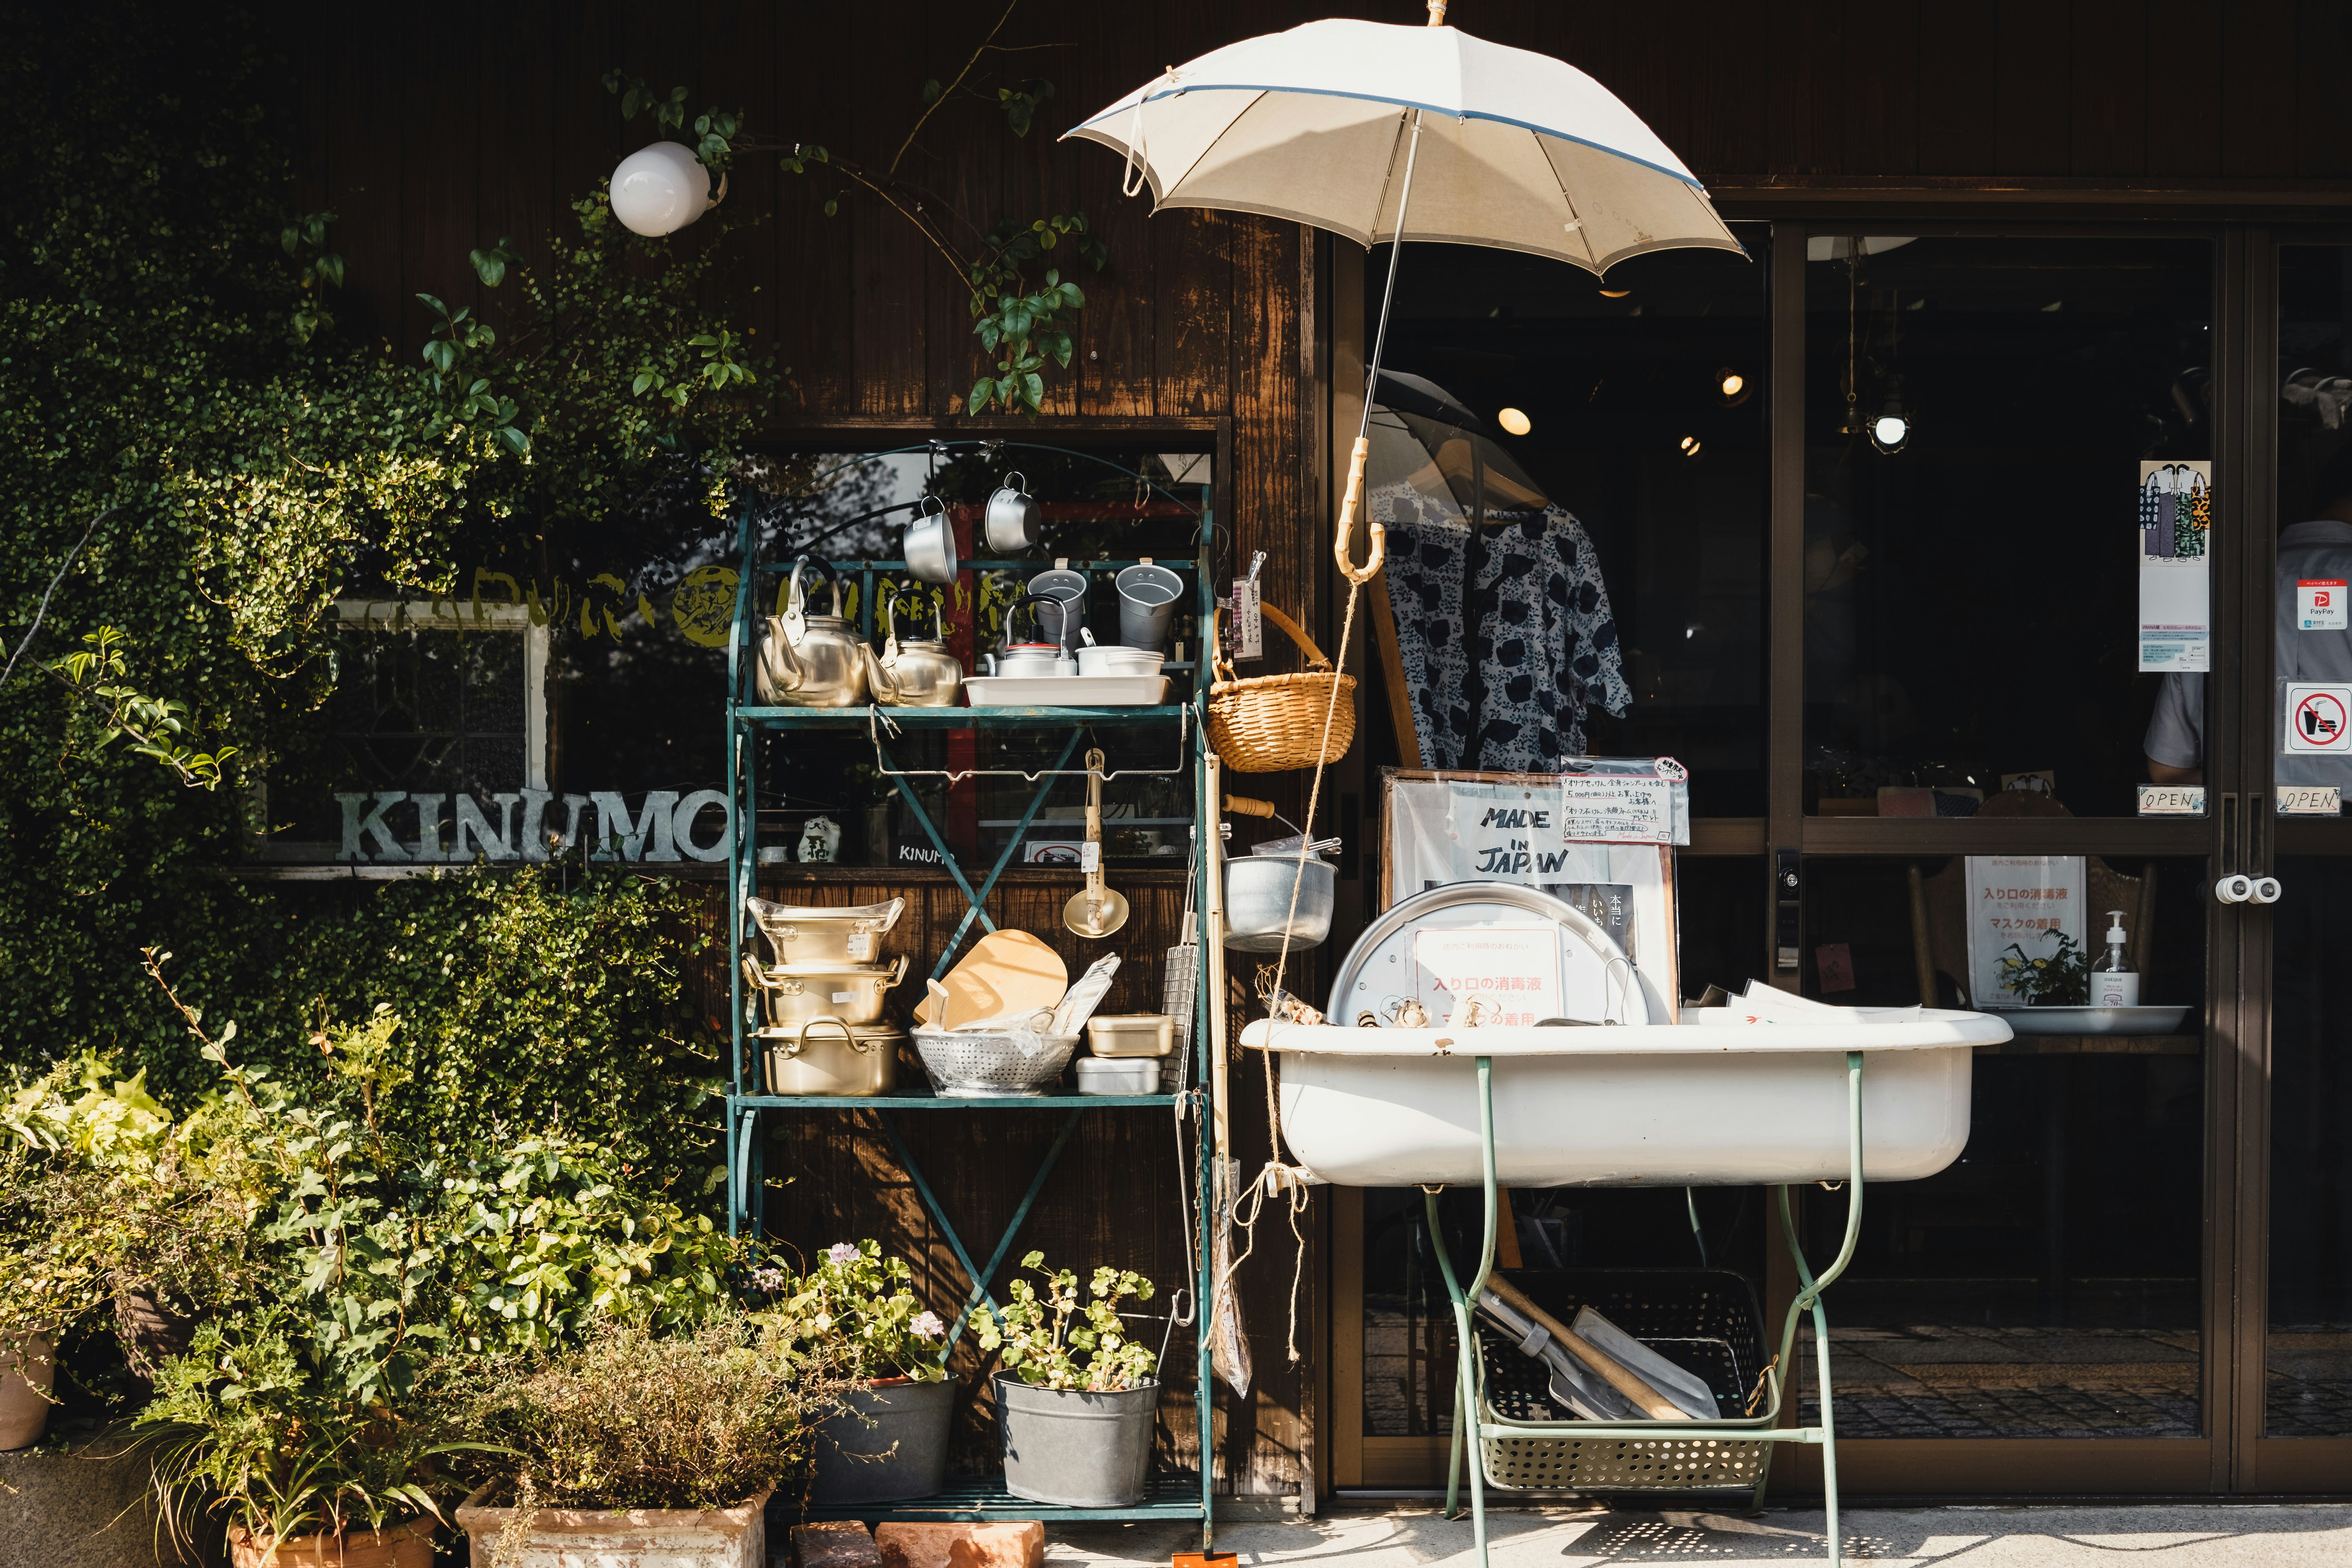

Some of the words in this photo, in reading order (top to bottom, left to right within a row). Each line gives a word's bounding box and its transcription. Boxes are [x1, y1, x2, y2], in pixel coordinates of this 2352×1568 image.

[2146, 793, 2193, 806] OPEN
[2285, 793, 2335, 807] OPEN
[334, 788, 745, 862] KINUMO
[1480, 807, 1550, 829] MADE
[1511, 839, 1529, 851] IN
[899, 845, 955, 865] KINUM
[1476, 847, 1569, 874] JAPAN
[1984, 887, 2068, 900] 入り口の消毒液
[1610, 895, 1622, 926] 本当に
[1990, 918, 2061, 930] マスクの着用
[1433, 976, 1542, 991] 入り口の消毒液
[1442, 1013, 1535, 1026] マクの着用
